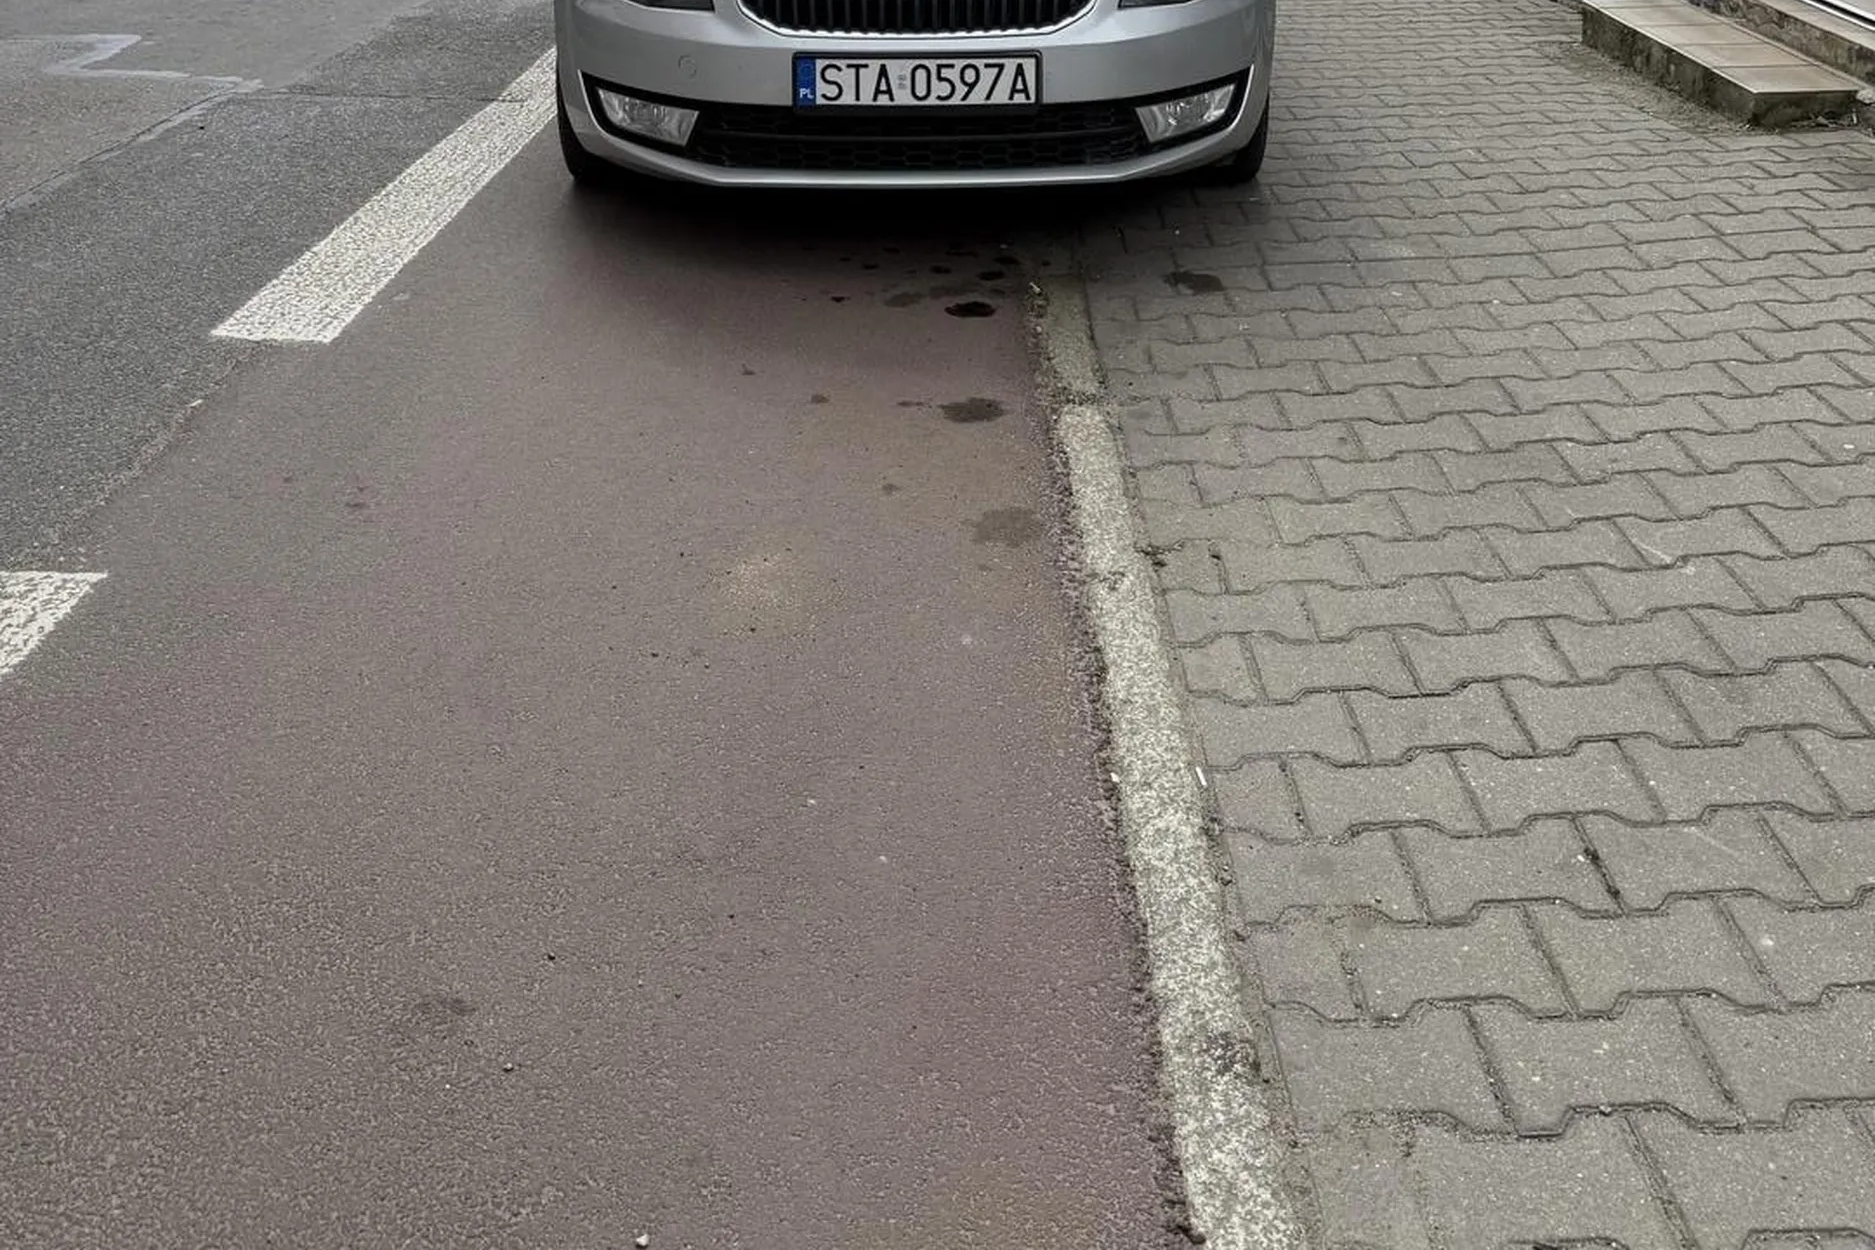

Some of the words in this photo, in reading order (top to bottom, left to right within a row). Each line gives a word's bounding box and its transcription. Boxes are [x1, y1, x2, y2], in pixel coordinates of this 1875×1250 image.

[799, 88, 815, 100] PL
[820, 63, 895, 102] STA
[910, 62, 1032, 102] 0597A
